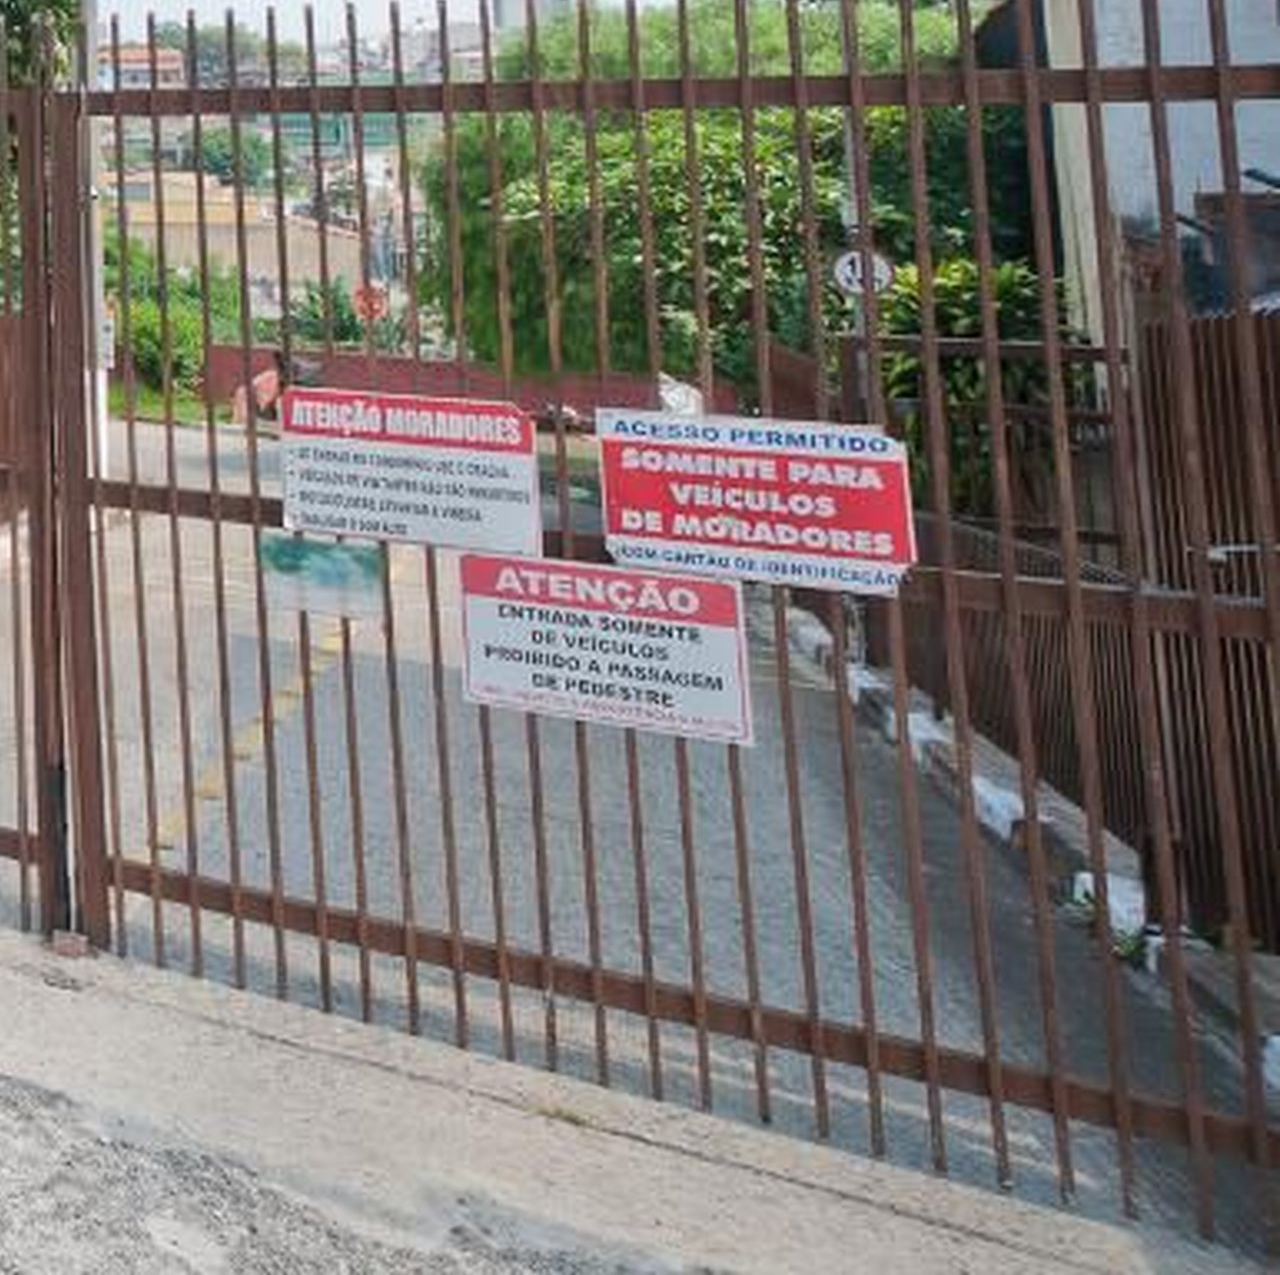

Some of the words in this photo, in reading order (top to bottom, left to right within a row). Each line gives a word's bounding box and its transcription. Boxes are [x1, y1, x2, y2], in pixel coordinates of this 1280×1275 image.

[293, 399, 381, 435] ATENÇÃO
[385, 407, 521, 445] MORADORES
[613, 419, 720, 442] ACESSO
[730, 429, 889, 453] PERMITIDO
[621, 447, 778, 481] SOMENTE
[789, 460, 884, 490] PARA
[669, 481, 838, 518] VEÍCULOS
[621, 509, 663, 533] DE
[673, 513, 894, 556] MORADORES
[734, 556, 755, 572] DE
[495, 566, 701, 616] ATENÇÃO
[498, 603, 591, 629] ENTRADA
[598, 615, 701, 642] SOMENTE
[531, 629, 556, 645] DE
[563, 633, 670, 662] VEÍCULOS
[484, 643, 581, 671] PROIBIDO
[587, 660, 601, 675] A
[607, 662, 724, 692] PASSAGEM
[531, 674, 559, 692] DE
[564, 680, 675, 708] PEDESTRE
